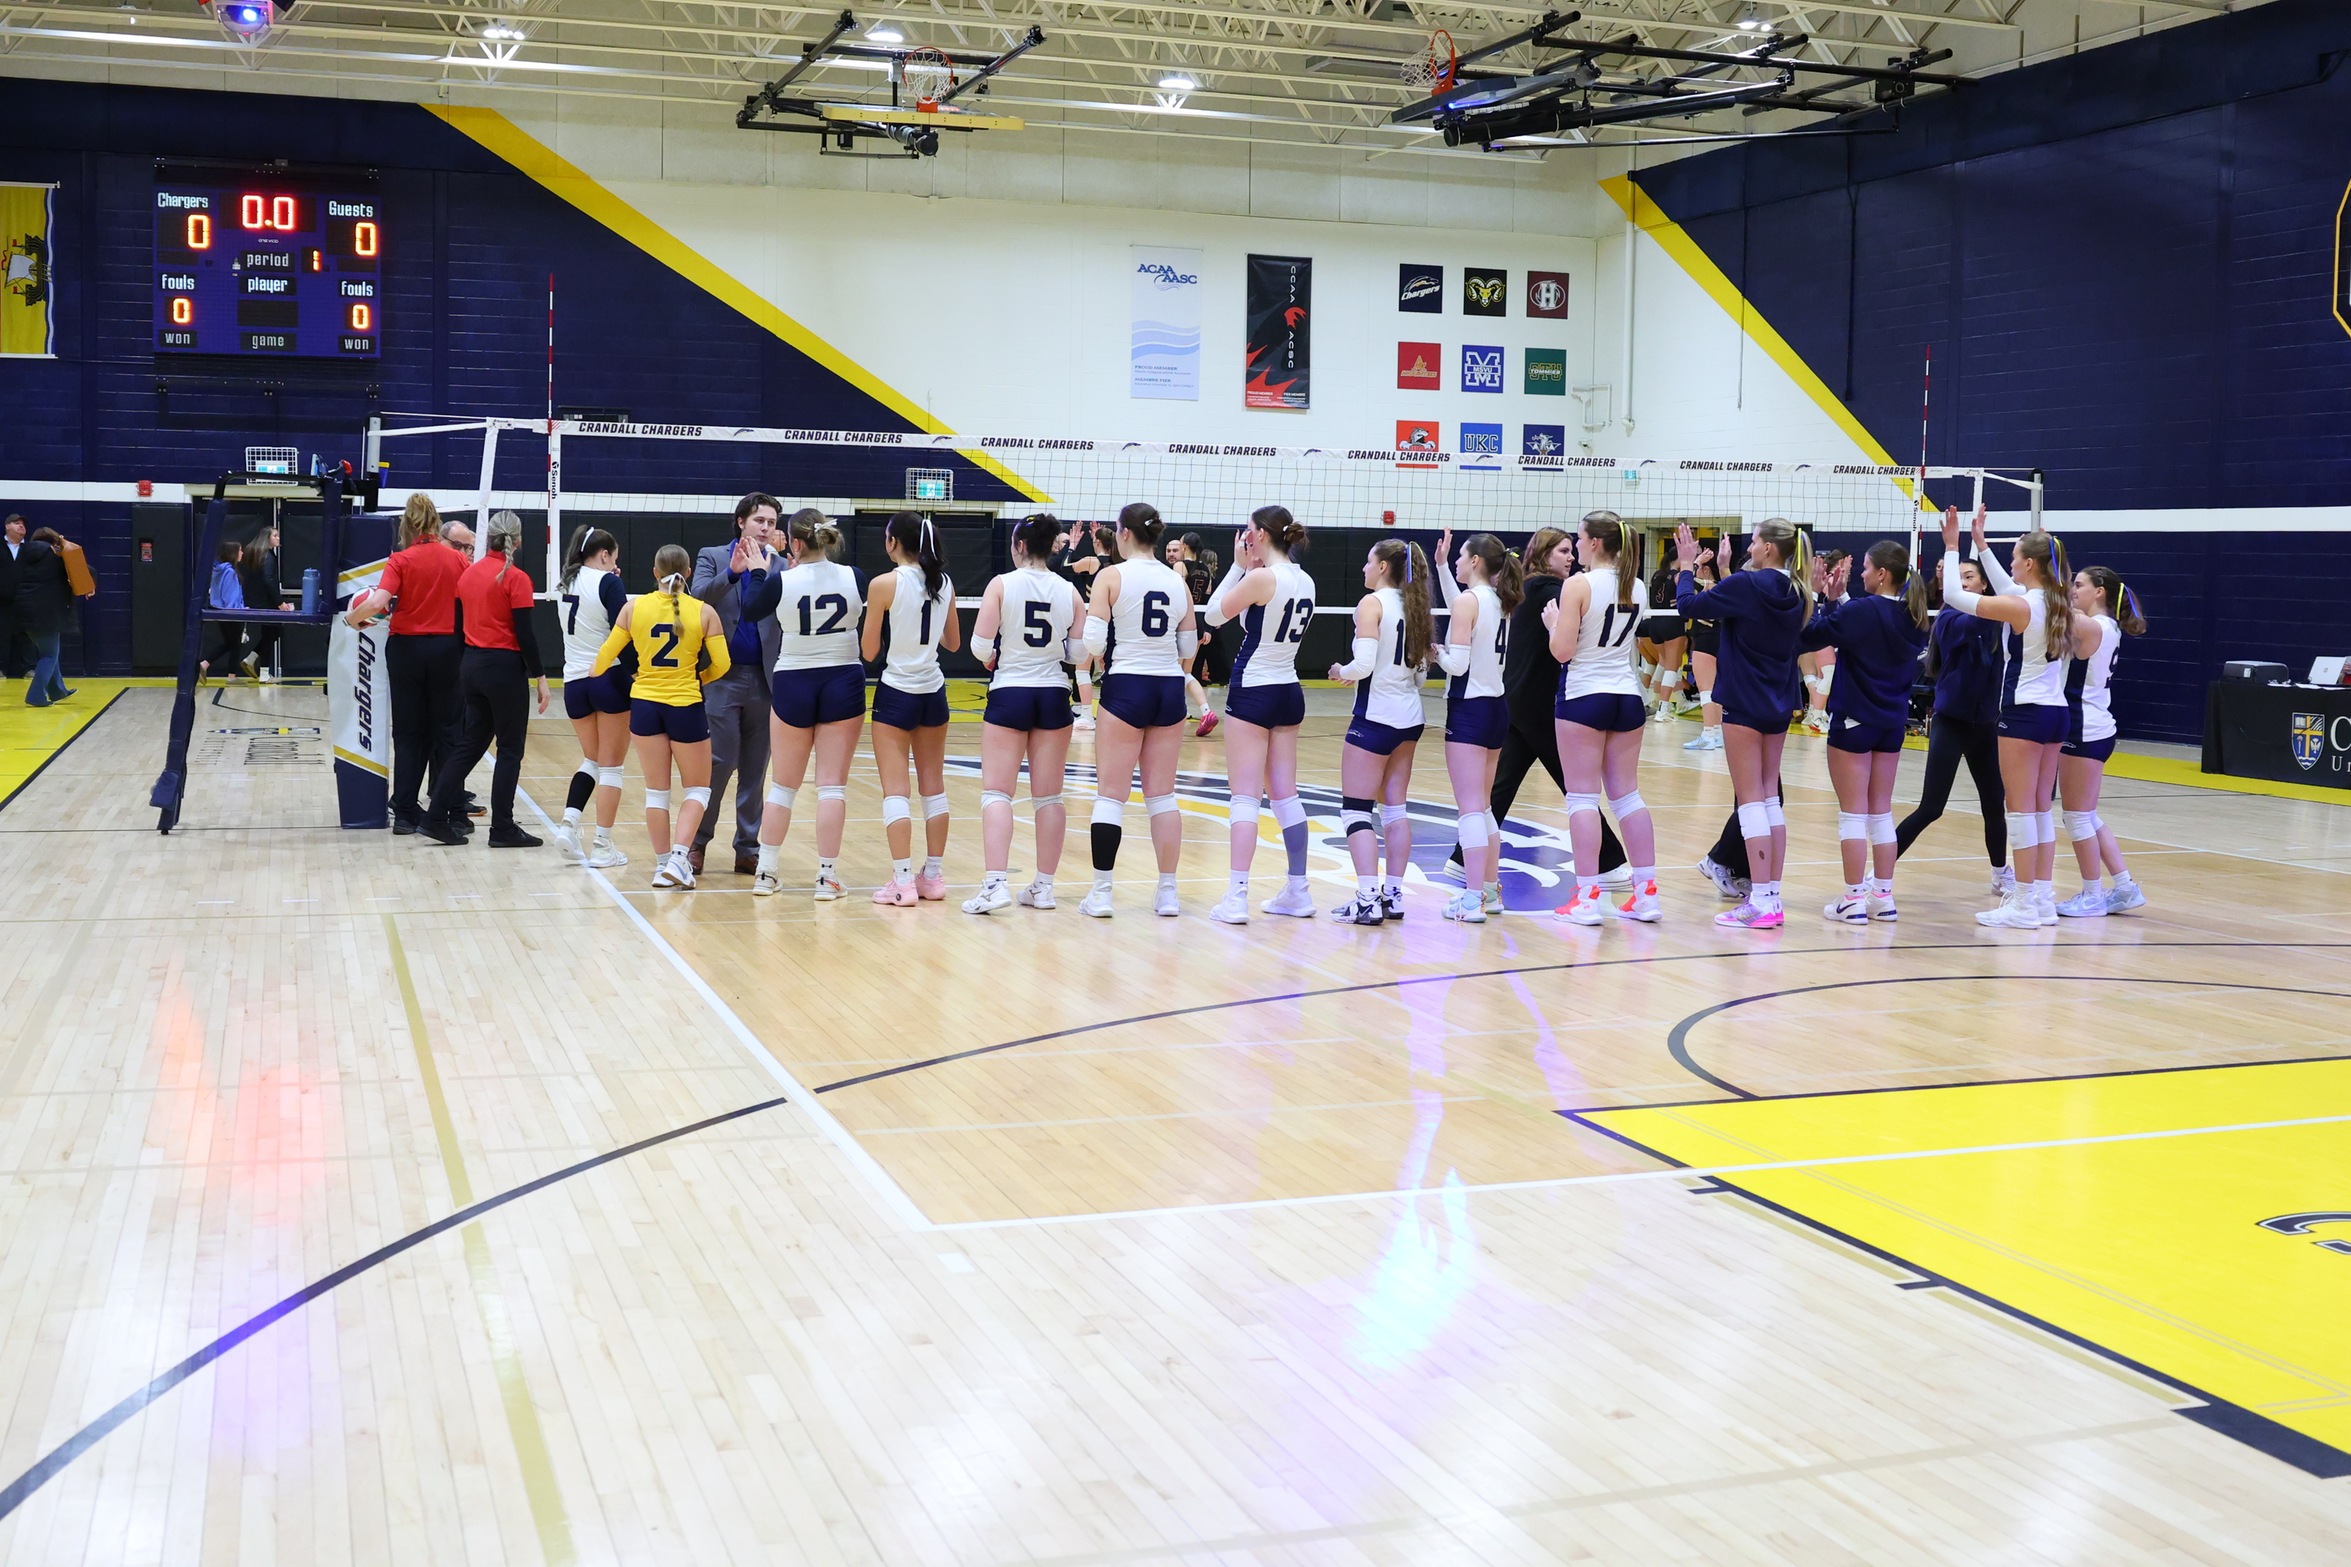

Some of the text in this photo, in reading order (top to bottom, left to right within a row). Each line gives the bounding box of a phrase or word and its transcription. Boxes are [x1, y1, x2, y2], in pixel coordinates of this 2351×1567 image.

[158, 192, 208, 208] Chargers
[241, 194, 294, 230] 0.0
[328, 201, 374, 217] Guests
[187, 214, 210, 249] 0
[355, 222, 377, 256] 0
[246, 253, 289, 267] period
[312, 250, 321, 271] 1
[1137, 264, 1175, 274] ACAA
[161, 274, 195, 290] fouls
[248, 277, 288, 293] player
[1162, 274, 1198, 284] AASC
[1289, 265, 1297, 303] CCAA
[341, 281, 374, 296] fouls
[1401, 284, 1441, 301] Chargers
[172, 298, 191, 324] 0
[352, 304, 369, 330] 0
[164, 332, 190, 345] won
[252, 334, 285, 349] game
[344, 338, 369, 350] won
[1287, 330, 1295, 369] ACSC
[578, 422, 702, 436] CRANDALL CHARGERS
[784, 430, 902, 444] CRANDALL CHARGERS
[981, 437, 1094, 450] CRANDALL CHARGERS
[1168, 444, 1276, 457] CRANDALL CHARGERS
[1464, 433, 1499, 452] UKC
[1348, 450, 1450, 462] CRANDALL CHARGERS
[1518, 456, 1616, 467] CRANDALL CHARGERS
[1680, 460, 1773, 472] CRANDALL CHARGERS
[1833, 464, 1916, 476] CRANDALL CHARGER
[562, 594, 580, 635] 7
[798, 593, 848, 636] 12
[1141, 590, 1170, 638] 6
[1274, 597, 1314, 644] 13
[1023, 600, 1052, 648] 5
[1598, 604, 1640, 648] 17
[650, 623, 679, 668] 2
[354, 631, 376, 752] Chargers
